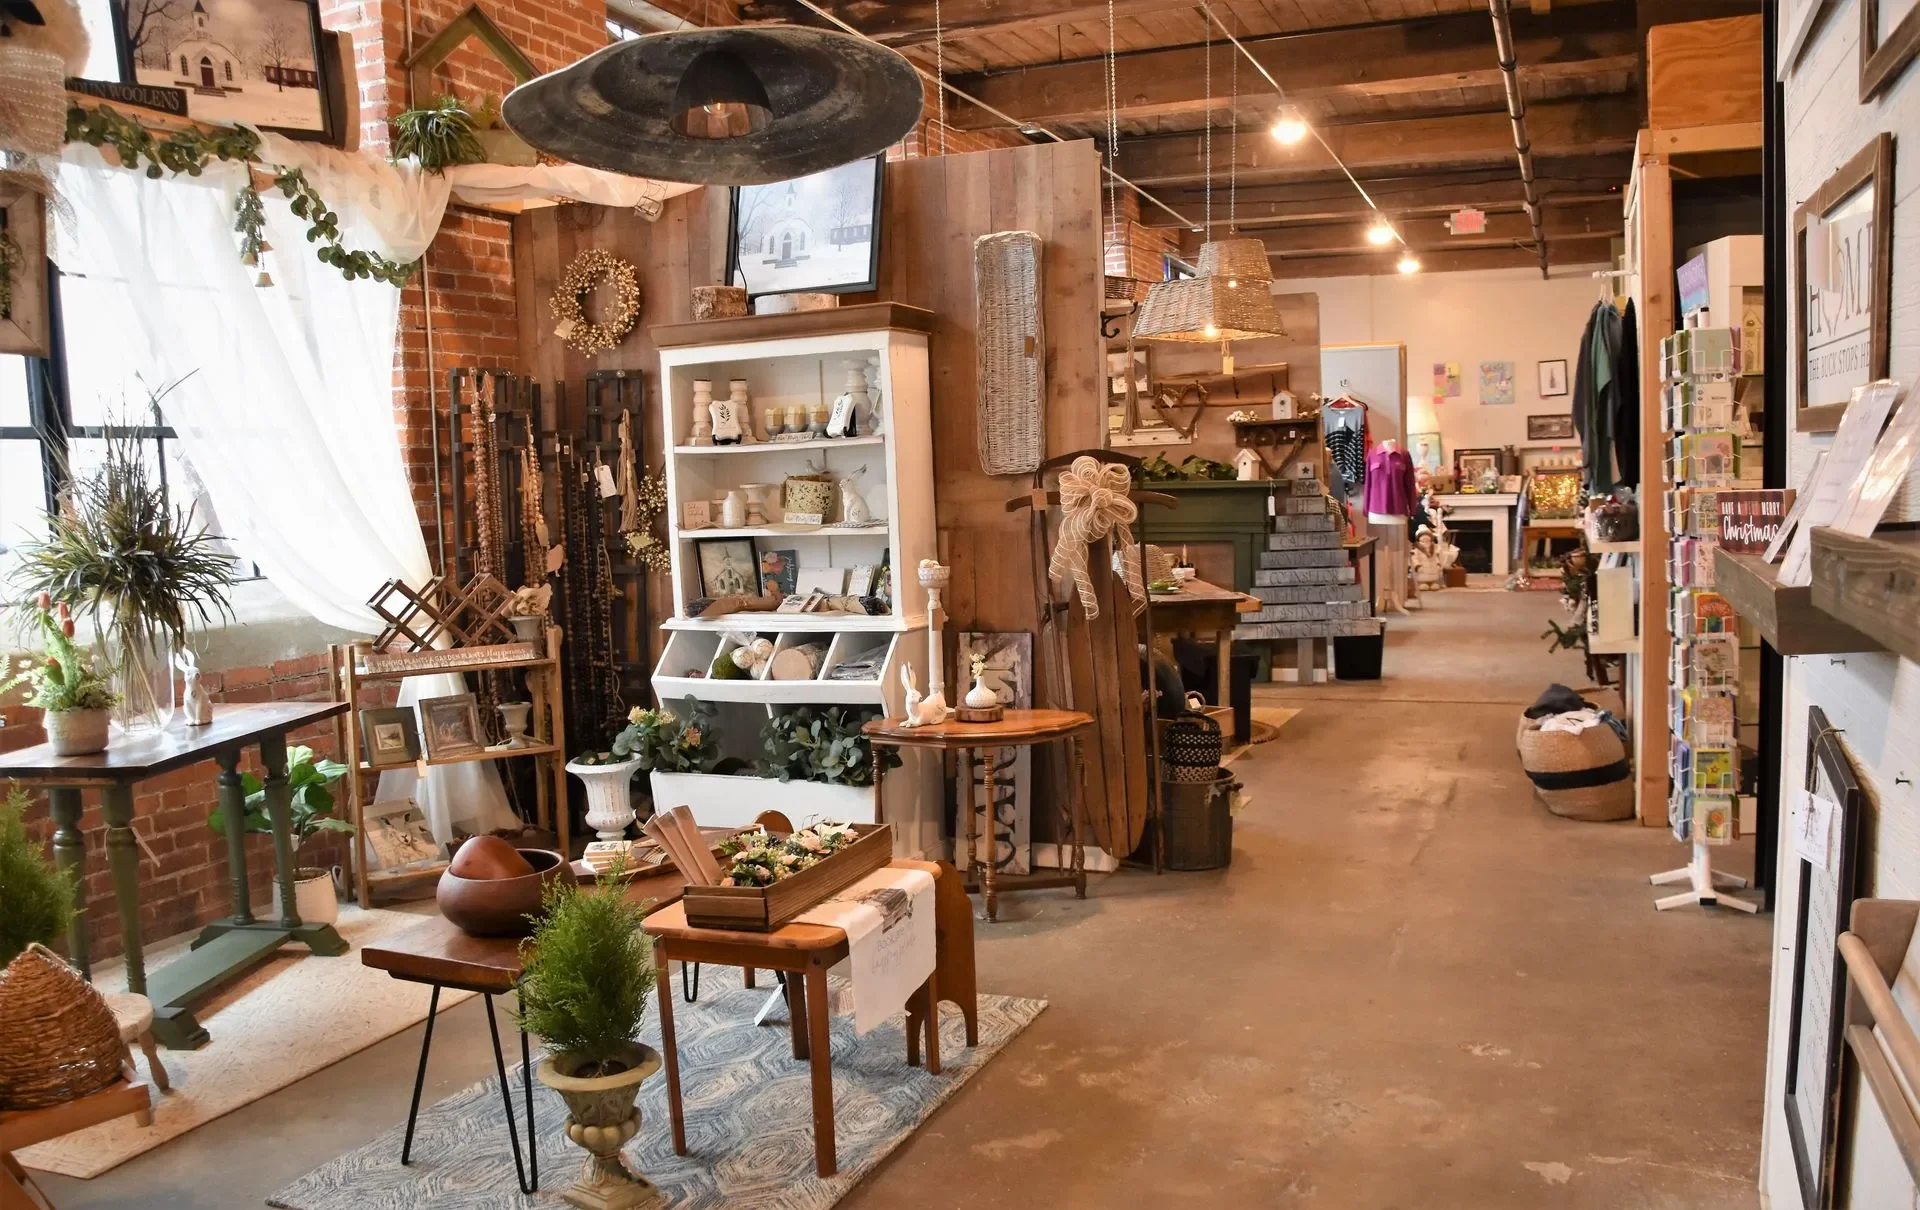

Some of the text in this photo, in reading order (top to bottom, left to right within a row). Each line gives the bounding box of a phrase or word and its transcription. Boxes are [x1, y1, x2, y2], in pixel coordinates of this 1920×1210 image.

[108, 84, 180, 111] WOOLENS
[1761, 501, 1780, 516] MERRY
[434, 654, 461, 662] GARDEN
